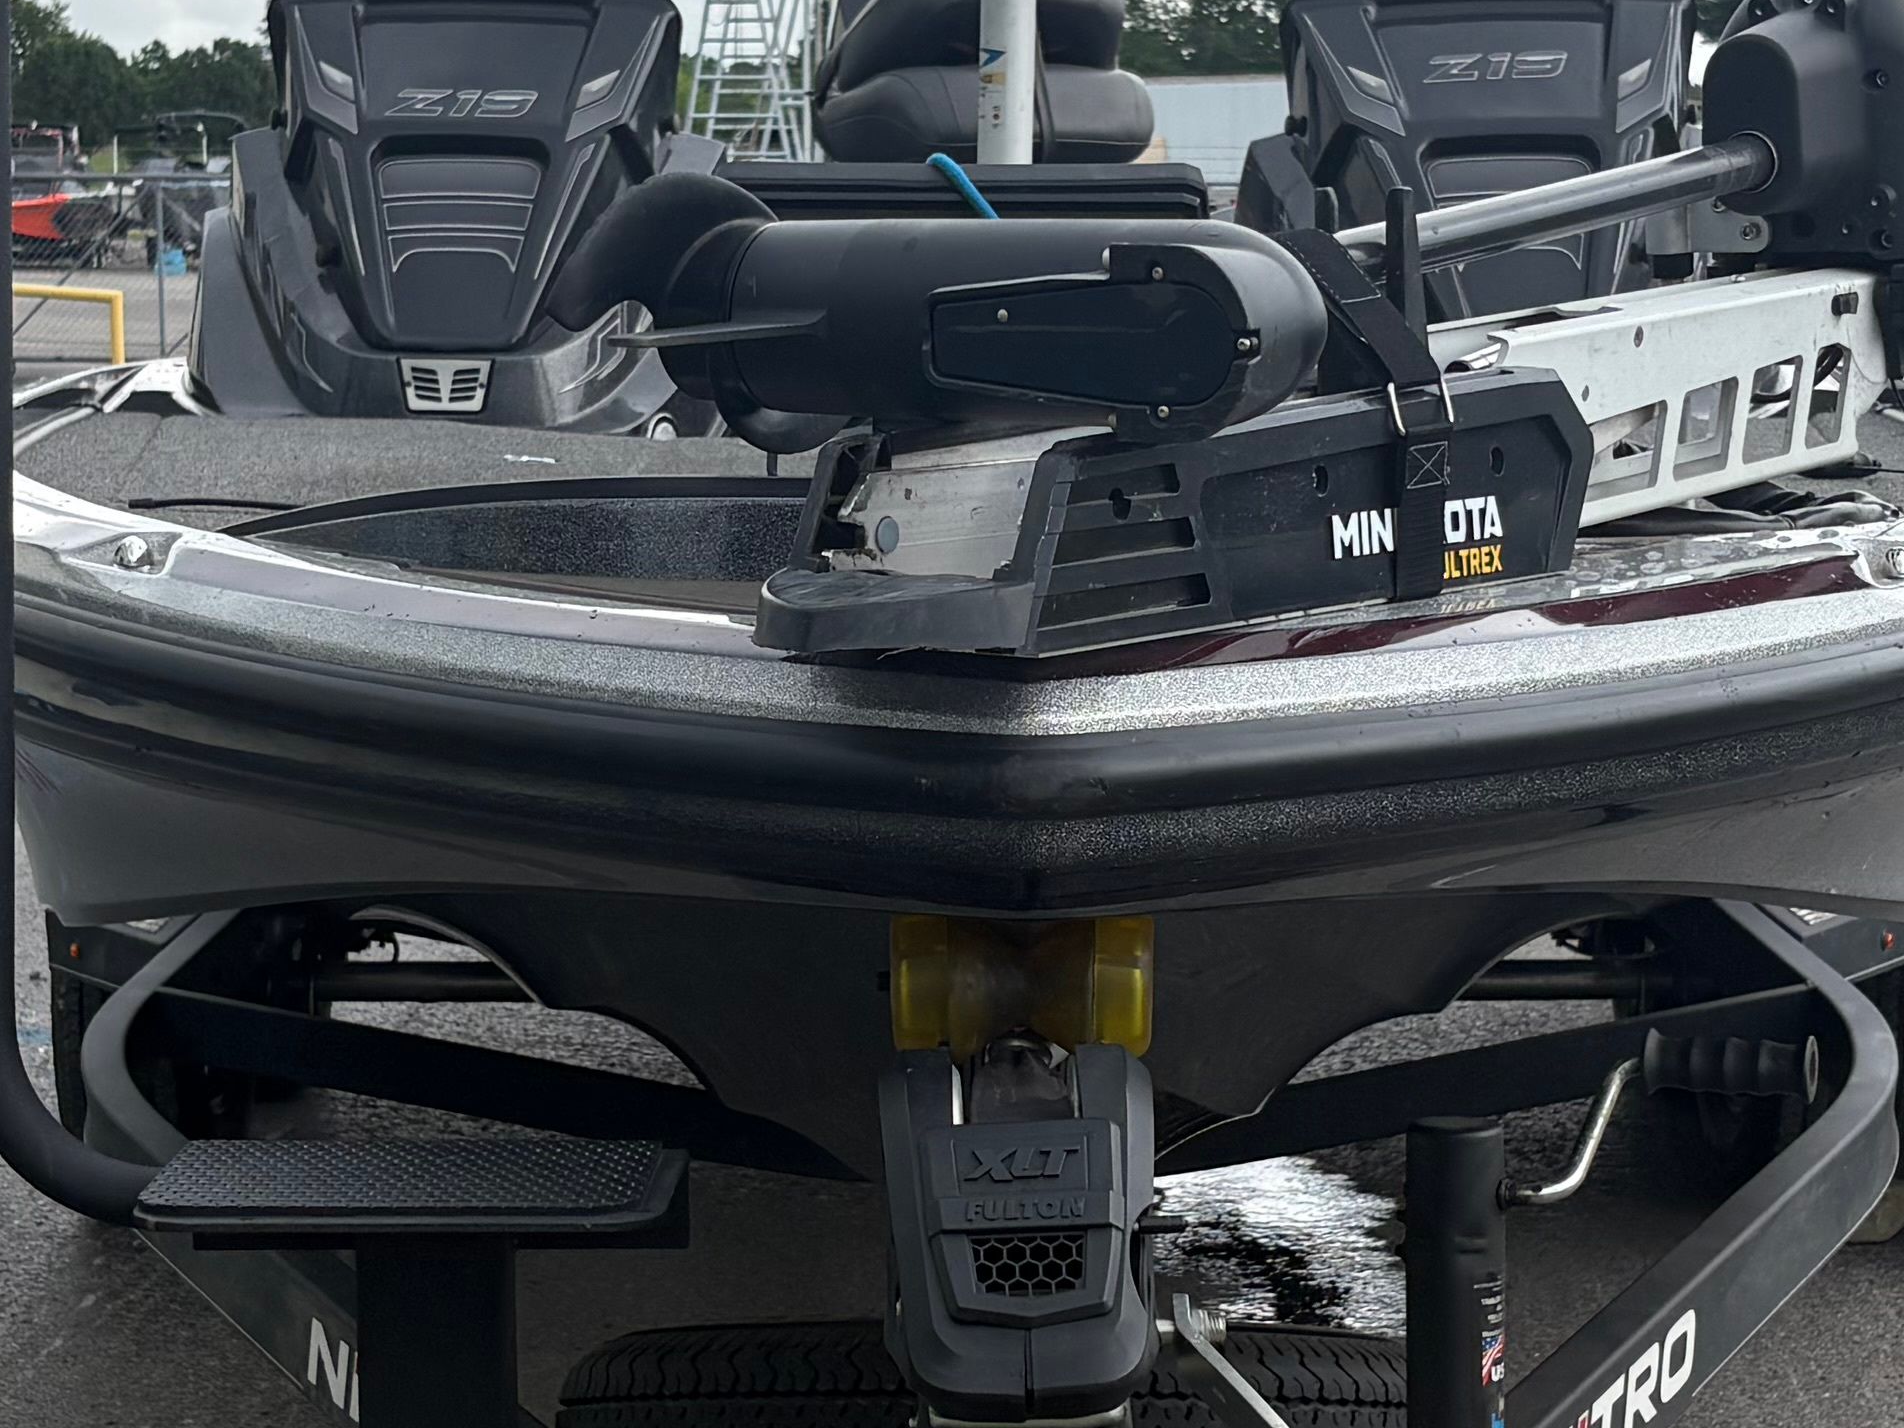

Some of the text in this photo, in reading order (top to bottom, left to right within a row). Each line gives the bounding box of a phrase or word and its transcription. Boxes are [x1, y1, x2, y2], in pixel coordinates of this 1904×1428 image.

[1423, 49, 1569, 84] Z19
[384, 88, 539, 118] Z19
[1331, 495, 1504, 560] MIN OTA
[963, 1145, 1082, 1184] XLT
[965, 1196, 1087, 1223] FULTON
